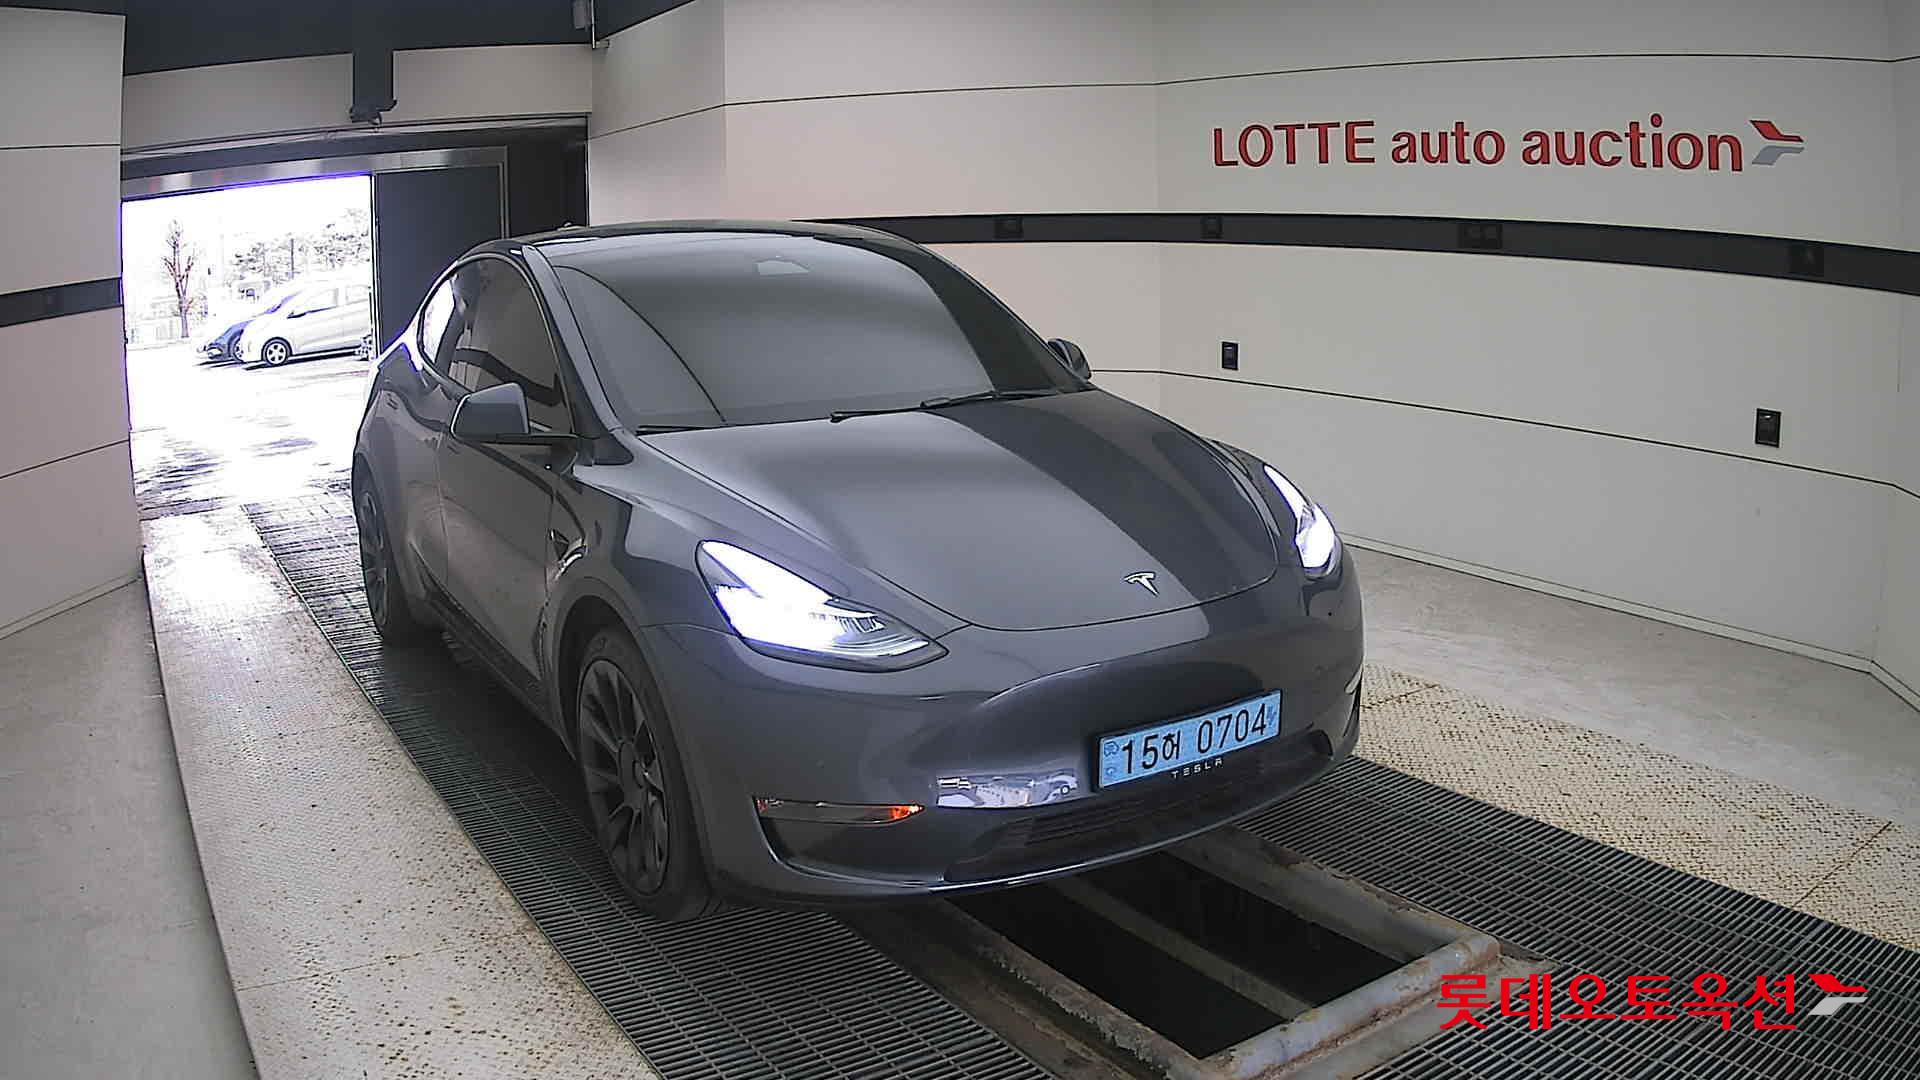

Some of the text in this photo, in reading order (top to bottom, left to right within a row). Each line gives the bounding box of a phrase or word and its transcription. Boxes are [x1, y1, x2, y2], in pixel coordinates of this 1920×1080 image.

[1213, 113, 1744, 172] LOTTE auto auction
[1121, 703, 1266, 774] 15허 0704
[1171, 757, 1224, 779] TESLA
